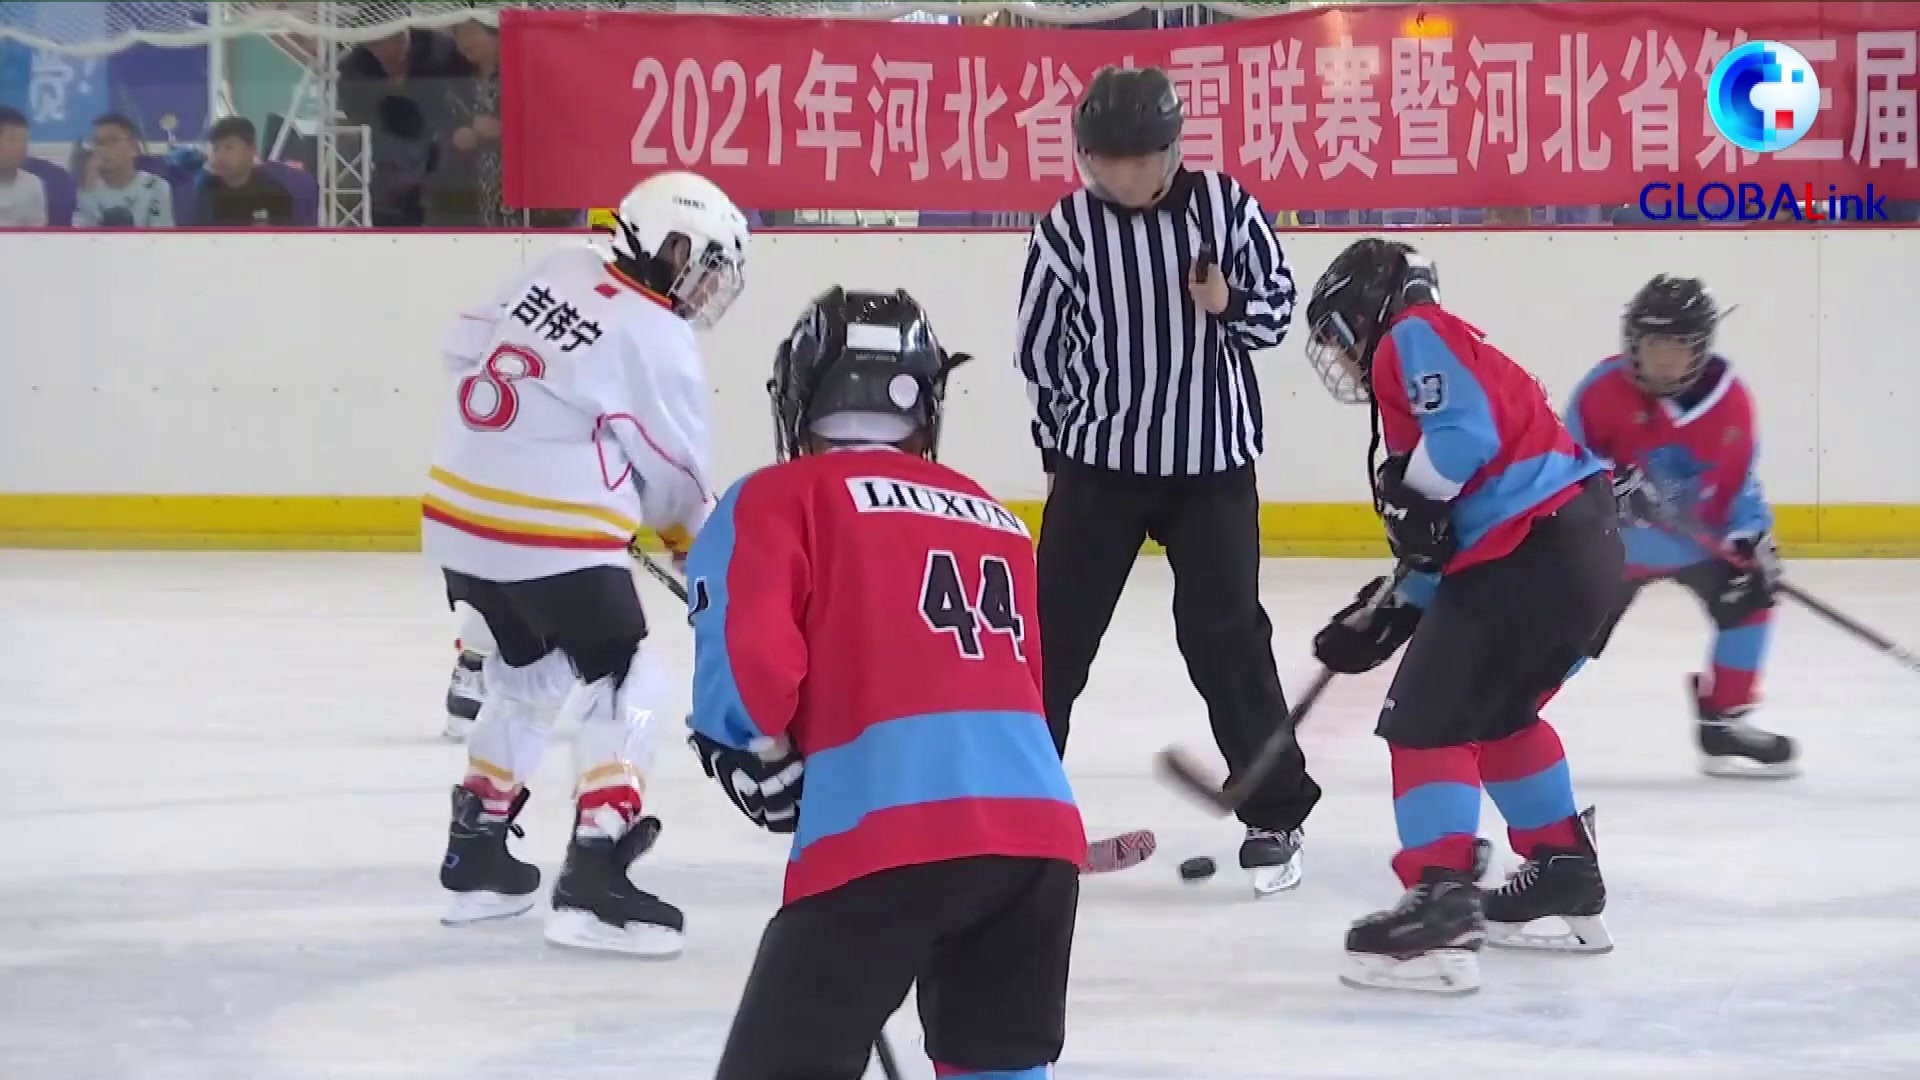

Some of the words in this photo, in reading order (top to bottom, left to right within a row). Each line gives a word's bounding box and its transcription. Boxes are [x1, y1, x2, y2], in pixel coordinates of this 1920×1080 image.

[631, 27, 1918, 181] 2021年河北省雪联赛暨河北省三届
[511, 284, 603, 352] 吉伟宁
[458, 343, 546, 432] 8
[861, 481, 1023, 531] LIUXUN
[918, 550, 1027, 662] 44
